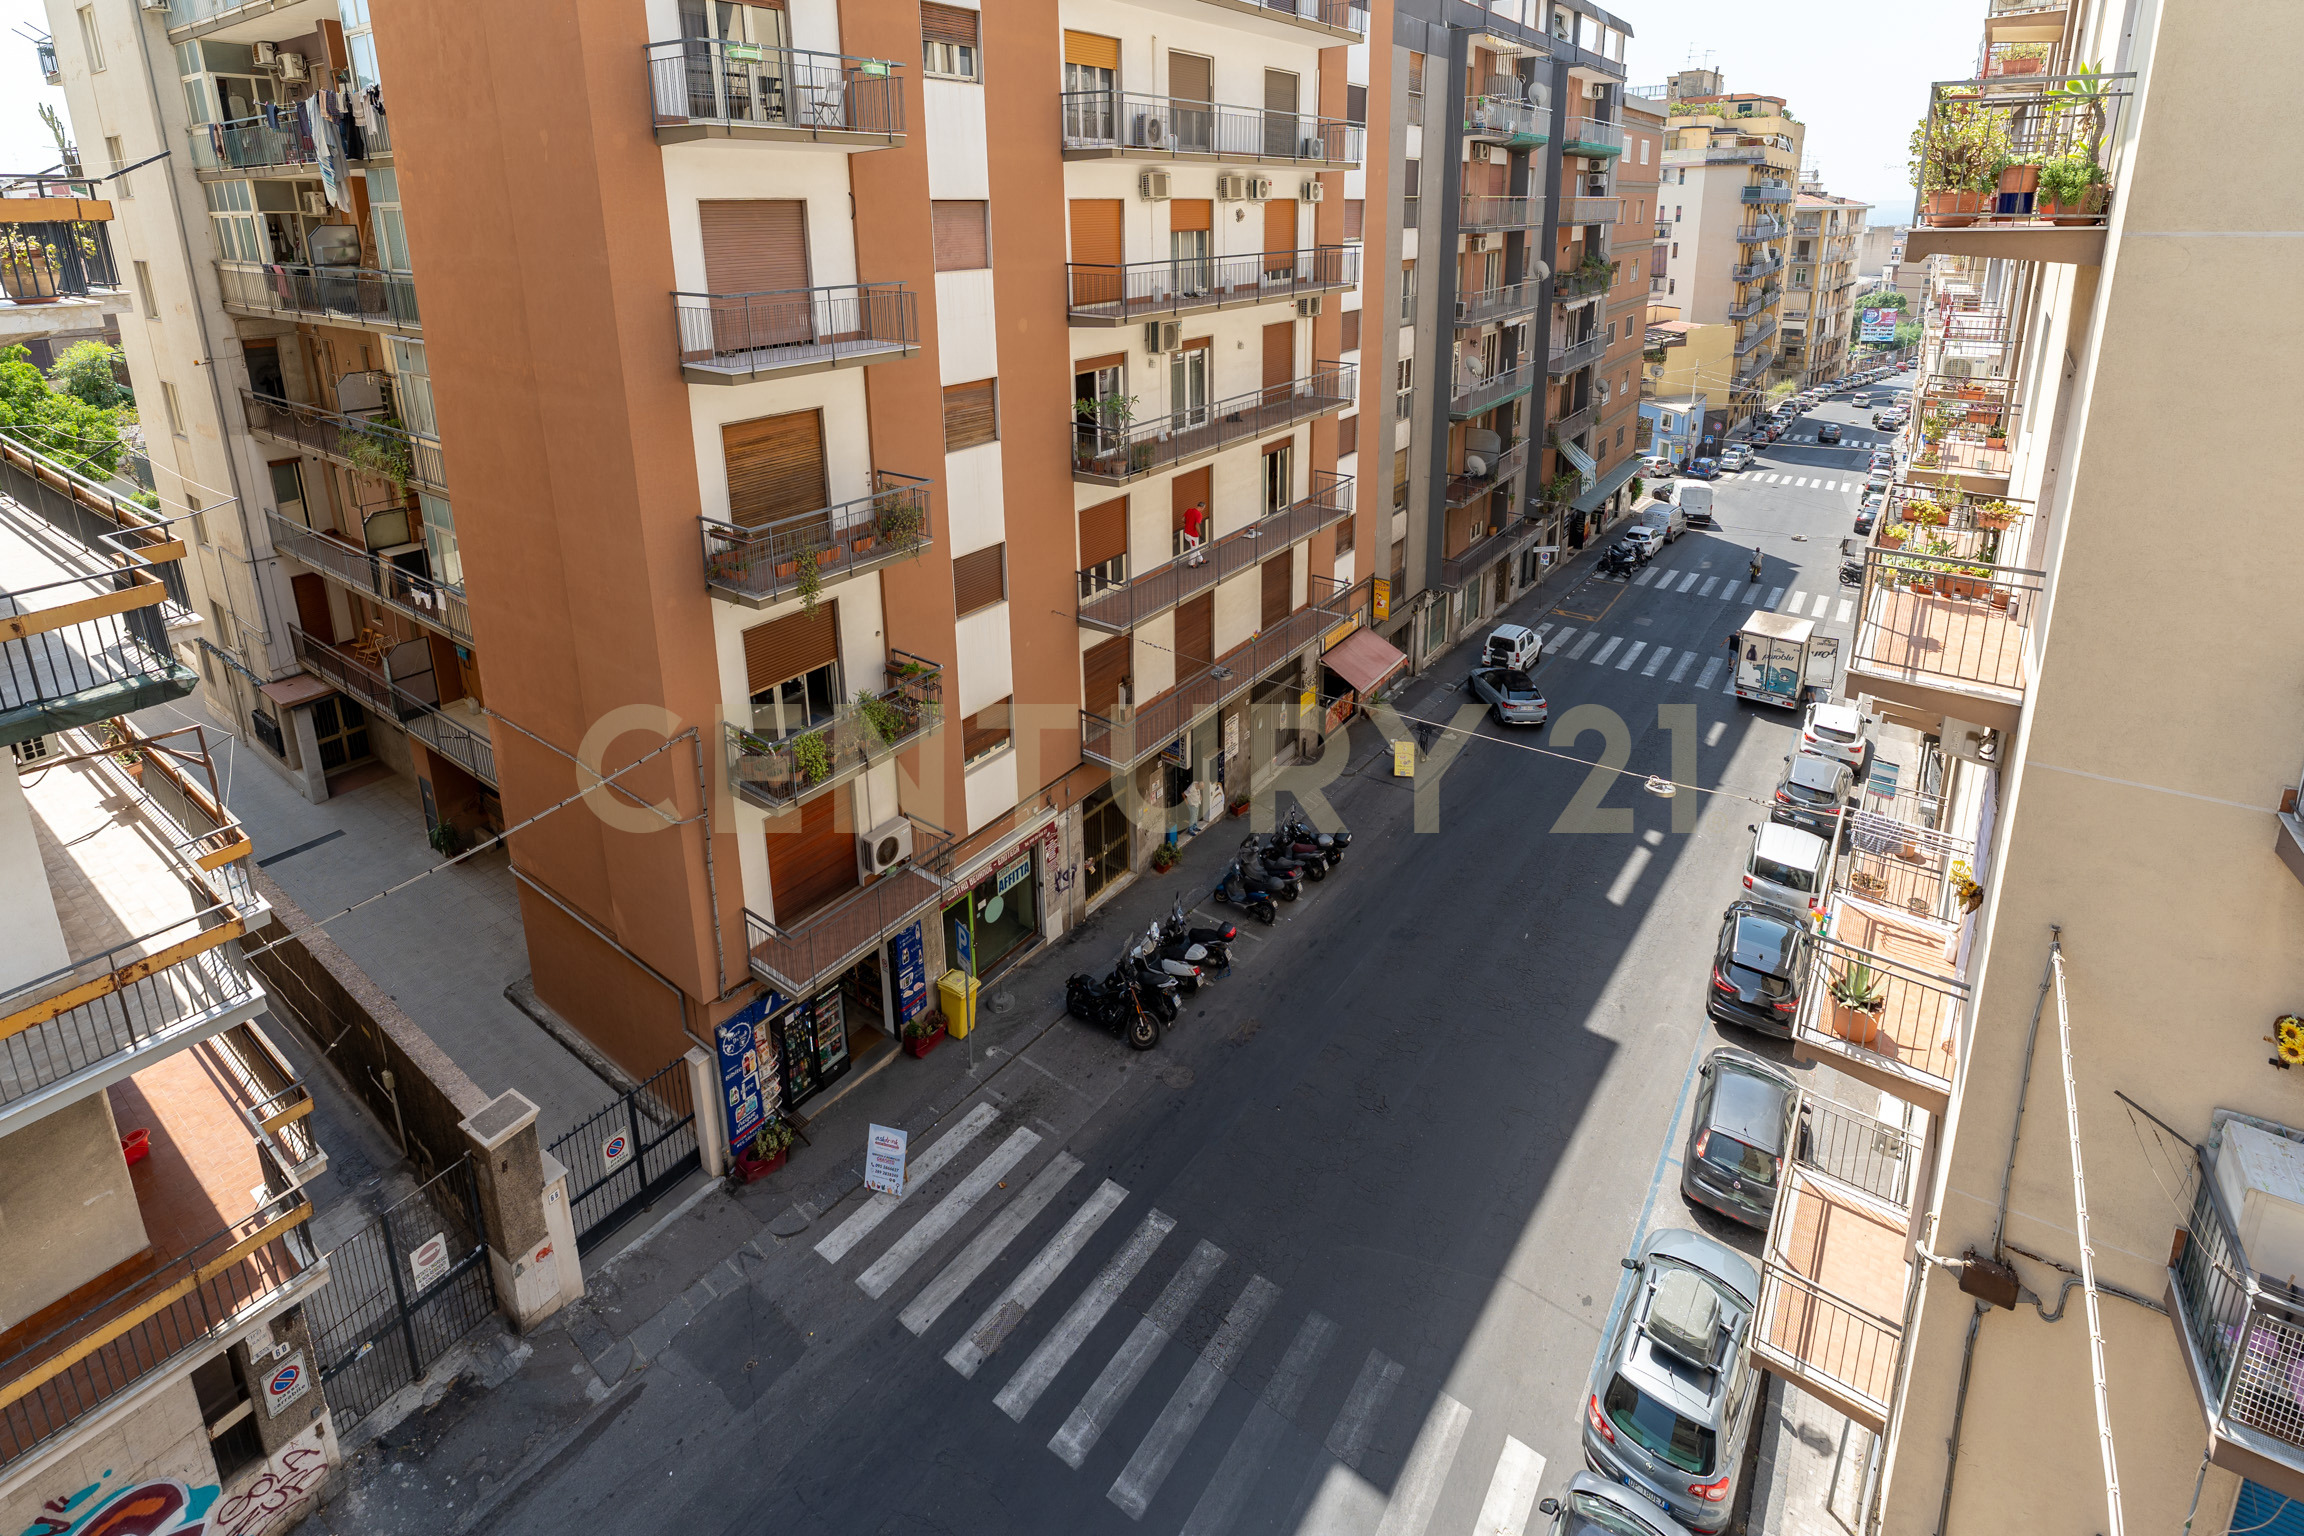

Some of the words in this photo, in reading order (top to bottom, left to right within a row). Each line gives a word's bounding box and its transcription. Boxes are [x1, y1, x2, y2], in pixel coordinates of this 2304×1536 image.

[998, 861, 1030, 893] AFFITTA
[957, 925, 967, 950] P
[277, 1383, 300, 1402] passo
